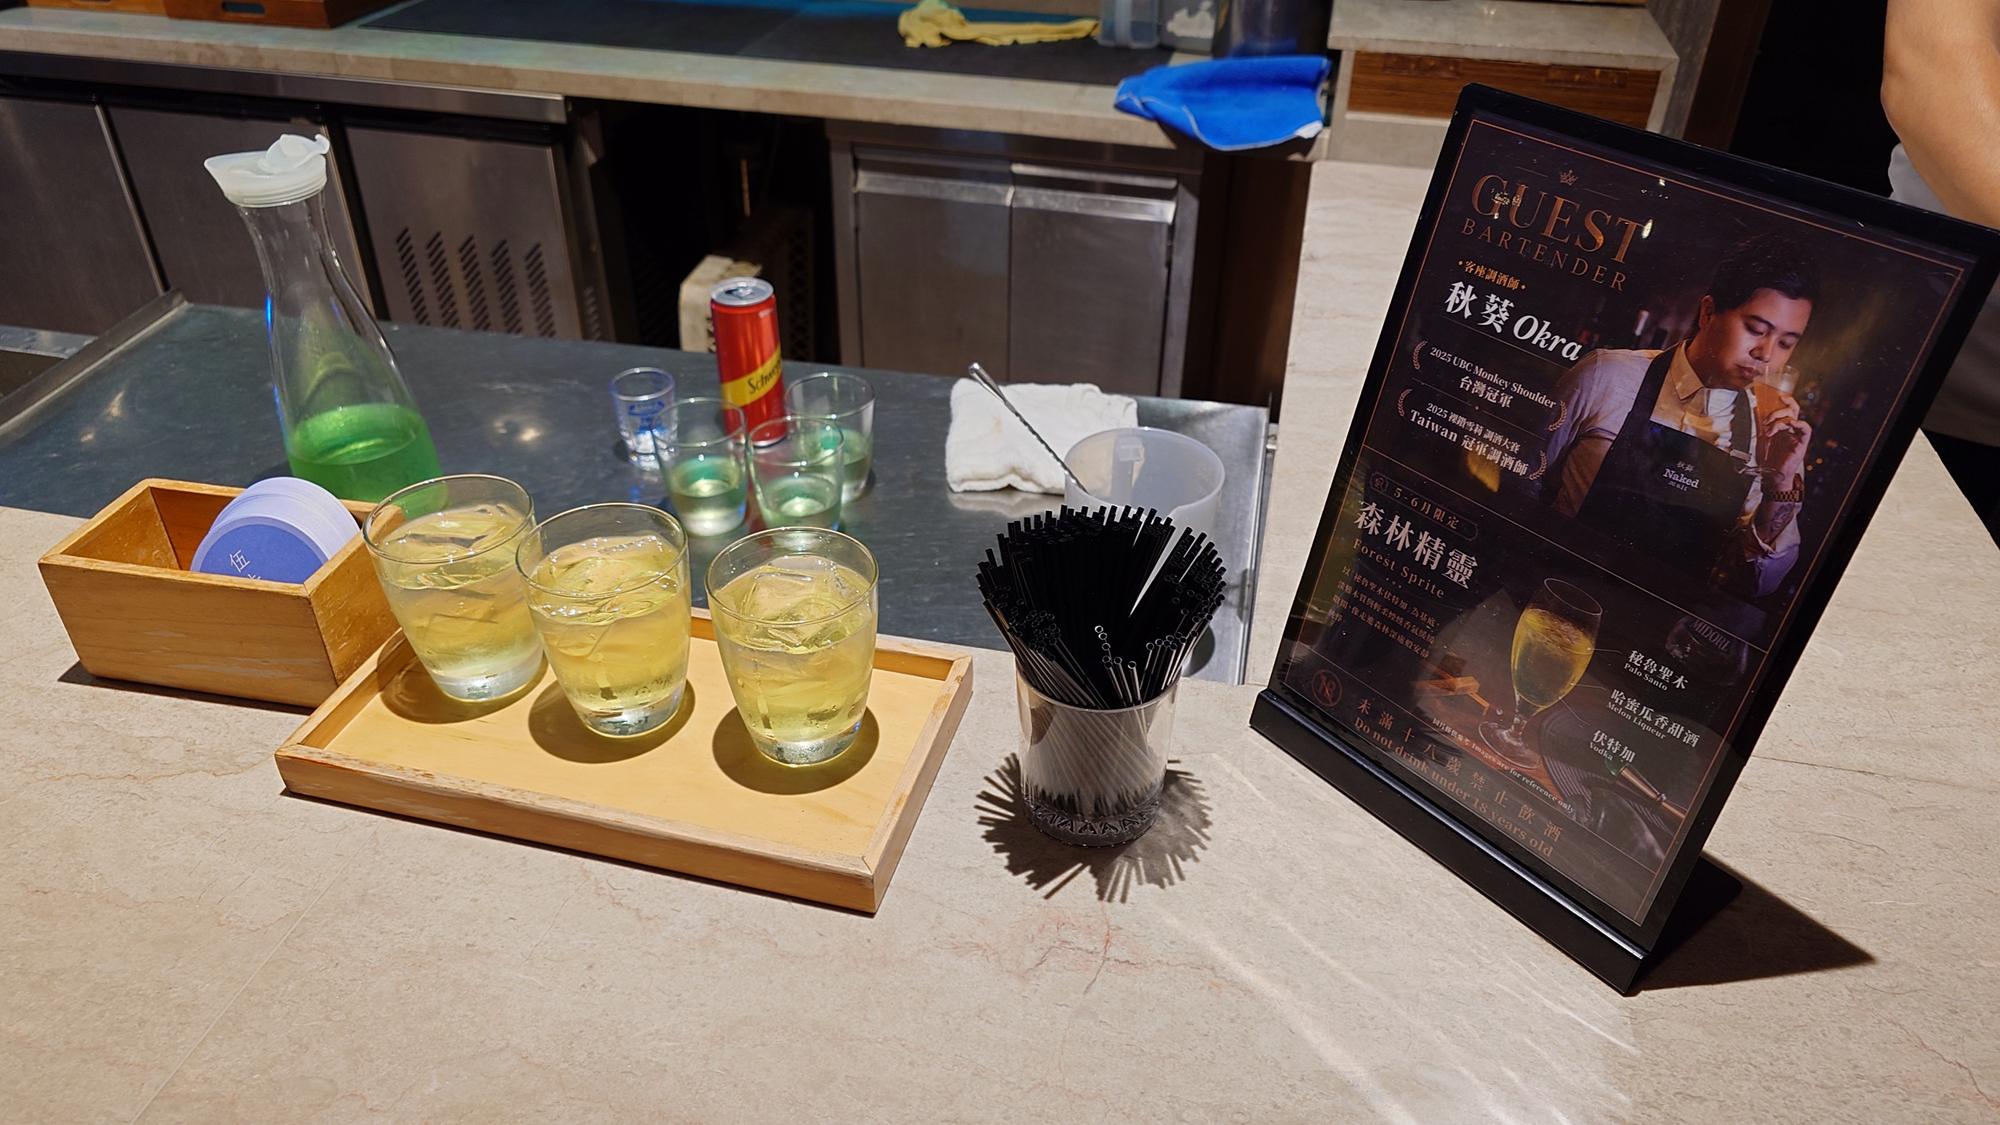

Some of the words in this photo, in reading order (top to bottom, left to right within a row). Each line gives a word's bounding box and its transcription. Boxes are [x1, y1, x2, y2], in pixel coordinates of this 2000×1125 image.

[1471, 174, 1646, 265] GUEST
[1461, 218, 1628, 292] BARTENDER
[1463, 261, 1520, 291] 客座調酒師
[1445, 281, 1515, 333] 秋葵
[1513, 314, 1583, 361] Okra
[1430, 347, 1452, 363] 2025
[1452, 356, 1474, 373] UBC
[1473, 365, 1511, 388] Monkey
[1511, 382, 1557, 409] Shoulder
[1459, 375, 1513, 409] 台灣冠軍
[1426, 403, 1448, 419] 2025
[1410, 409, 1458, 442] Taiwan
[1461, 434, 1529, 477] 冠軍調酒師
[1663, 468, 1700, 489] Naked
[1353, 538, 1396, 572] Forest
[1400, 565, 1446, 599] Sprite
[1354, 501, 1478, 590] 森林精靈
[1624, 662, 1643, 678] Palo
[1644, 672, 1668, 691] Santo
[1592, 729, 1636, 763] 伏特加
[1606, 701, 1632, 722] Melon
[1633, 716, 1667, 740] Liqueur
[1611, 689, 1700, 748] 哈蜜瓜香甜酒
[1358, 699, 1563, 842] 未滿十八歲禁止飲酒
[1589, 742, 1614, 761] Vodka
[1354, 717, 1370, 735] Do
[1373, 731, 1393, 750] not
[1395, 746, 1429, 774] drink
[1431, 770, 1470, 800] under
[1473, 799, 1488, 813] 18
[1491, 811, 1527, 840] years
[1529, 837, 1554, 858] old
[1509, 767, 1522, 778] for
[1521, 776, 1557, 801] reference
